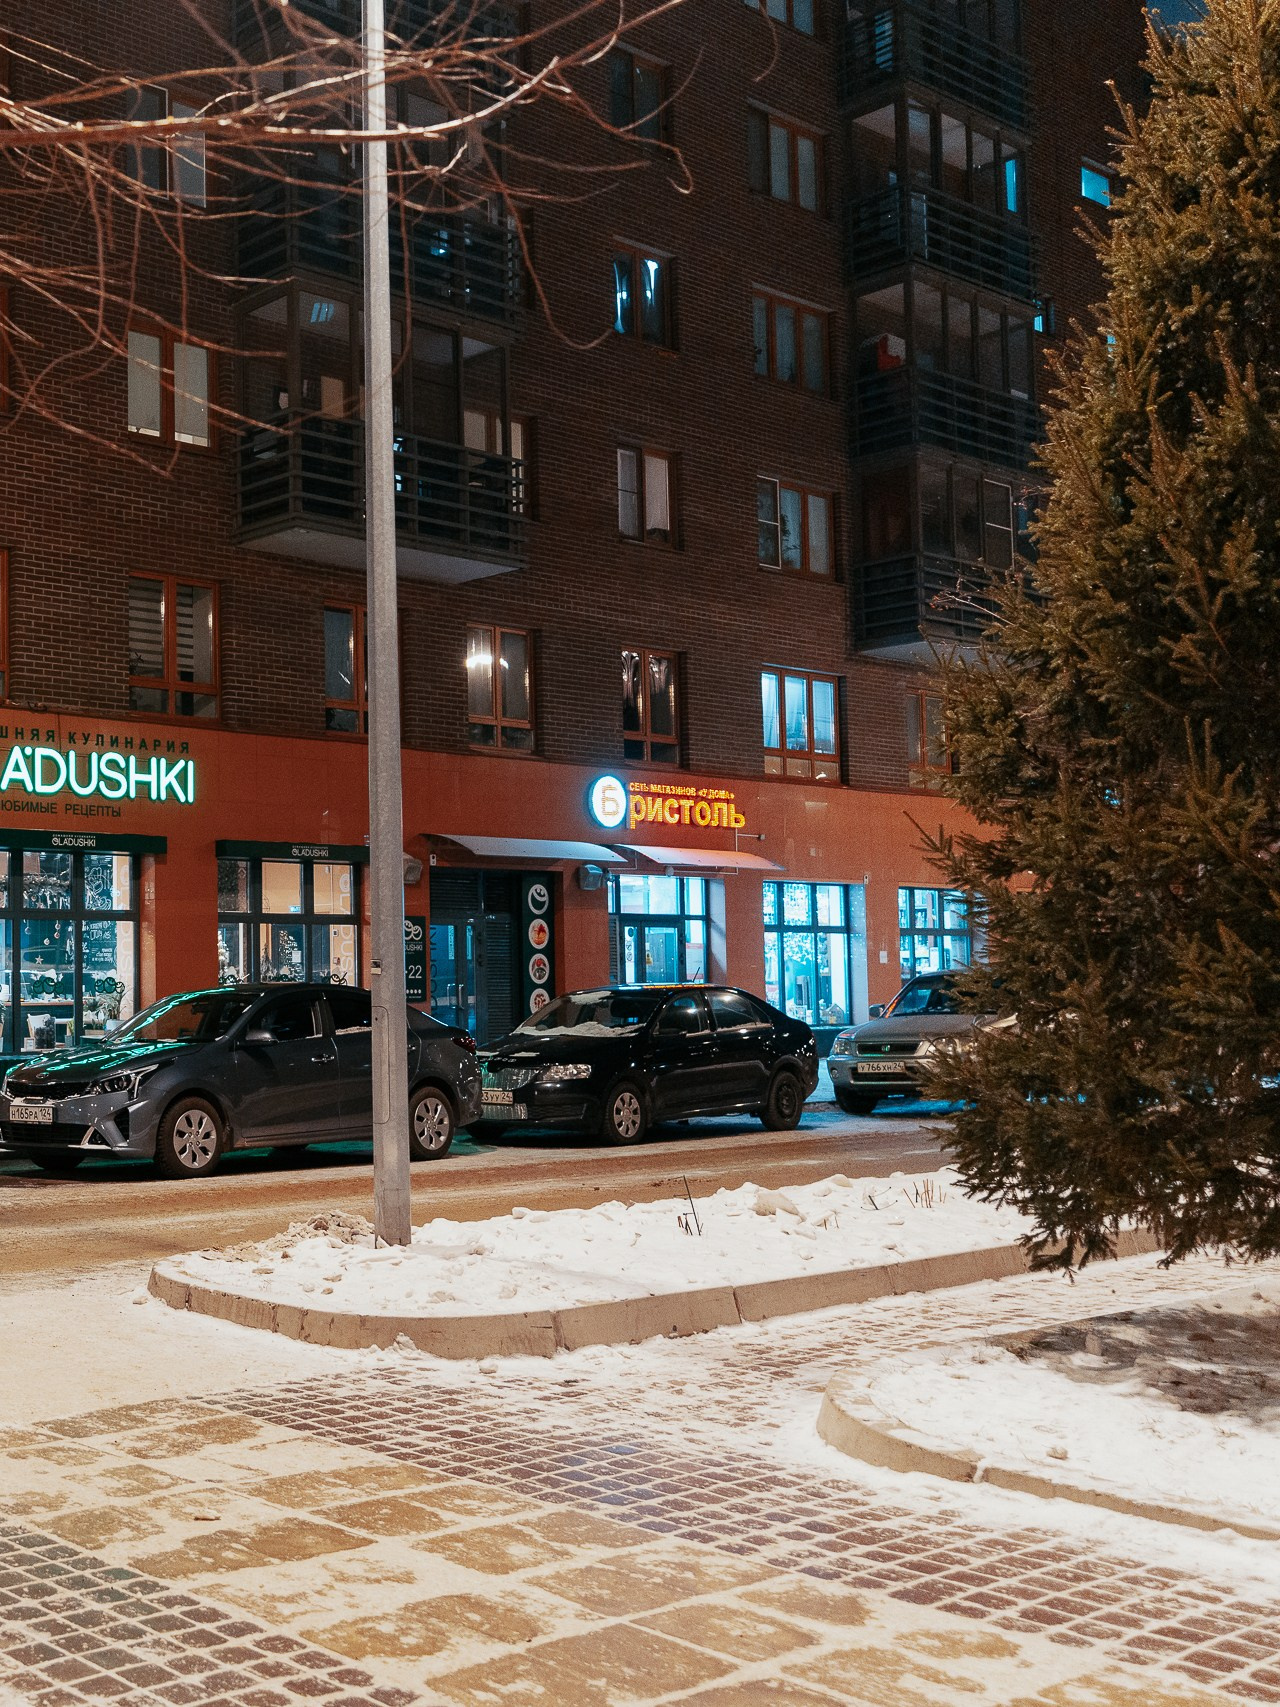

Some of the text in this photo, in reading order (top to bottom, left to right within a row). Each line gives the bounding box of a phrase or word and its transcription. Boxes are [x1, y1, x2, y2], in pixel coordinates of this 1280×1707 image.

[68, 731, 190, 754] КУЛИНАРИЯ
[629, 782, 649, 792] СЕТЬ
[650, 784, 696, 797] МАГАЗИНОВ
[64, 803, 121, 818] РЕЦЕПТЫ
[40, 1108, 51, 1118] 124
